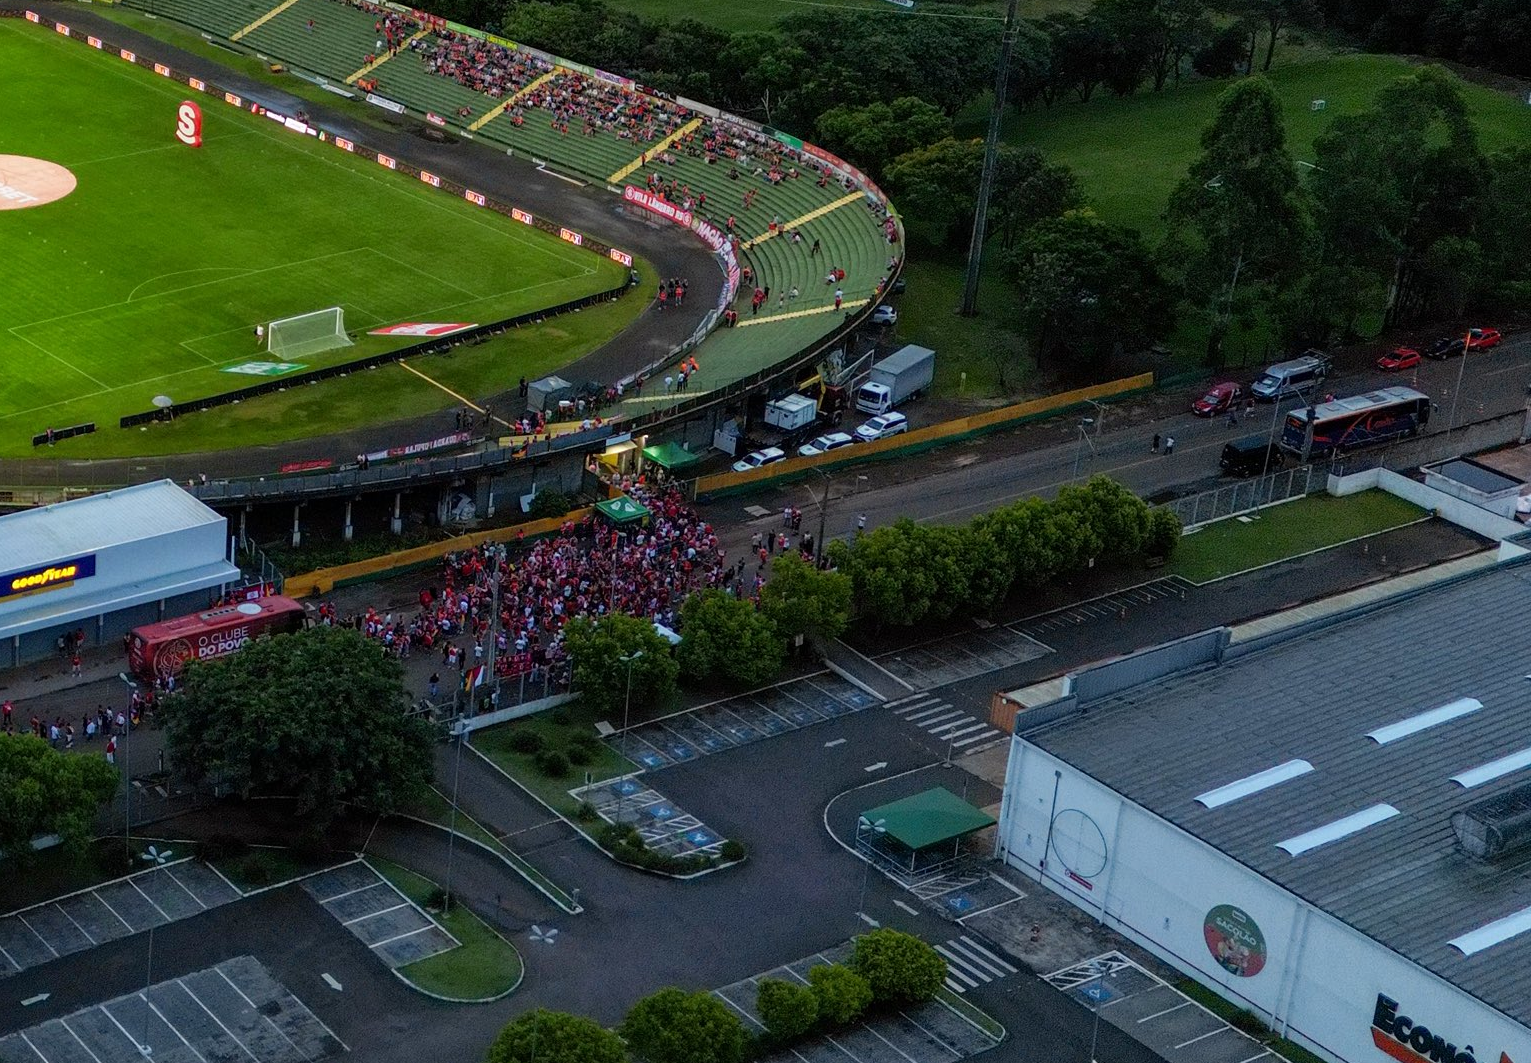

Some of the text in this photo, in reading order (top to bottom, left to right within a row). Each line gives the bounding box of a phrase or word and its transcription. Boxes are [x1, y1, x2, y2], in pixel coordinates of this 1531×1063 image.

[635, 84, 676, 102] COMIL
[11, 565, 76, 590] GOODYEAR
[198, 625, 251, 647] O CLUBE
[199, 644, 216, 657] DO
[218, 636, 250, 652] POVO
